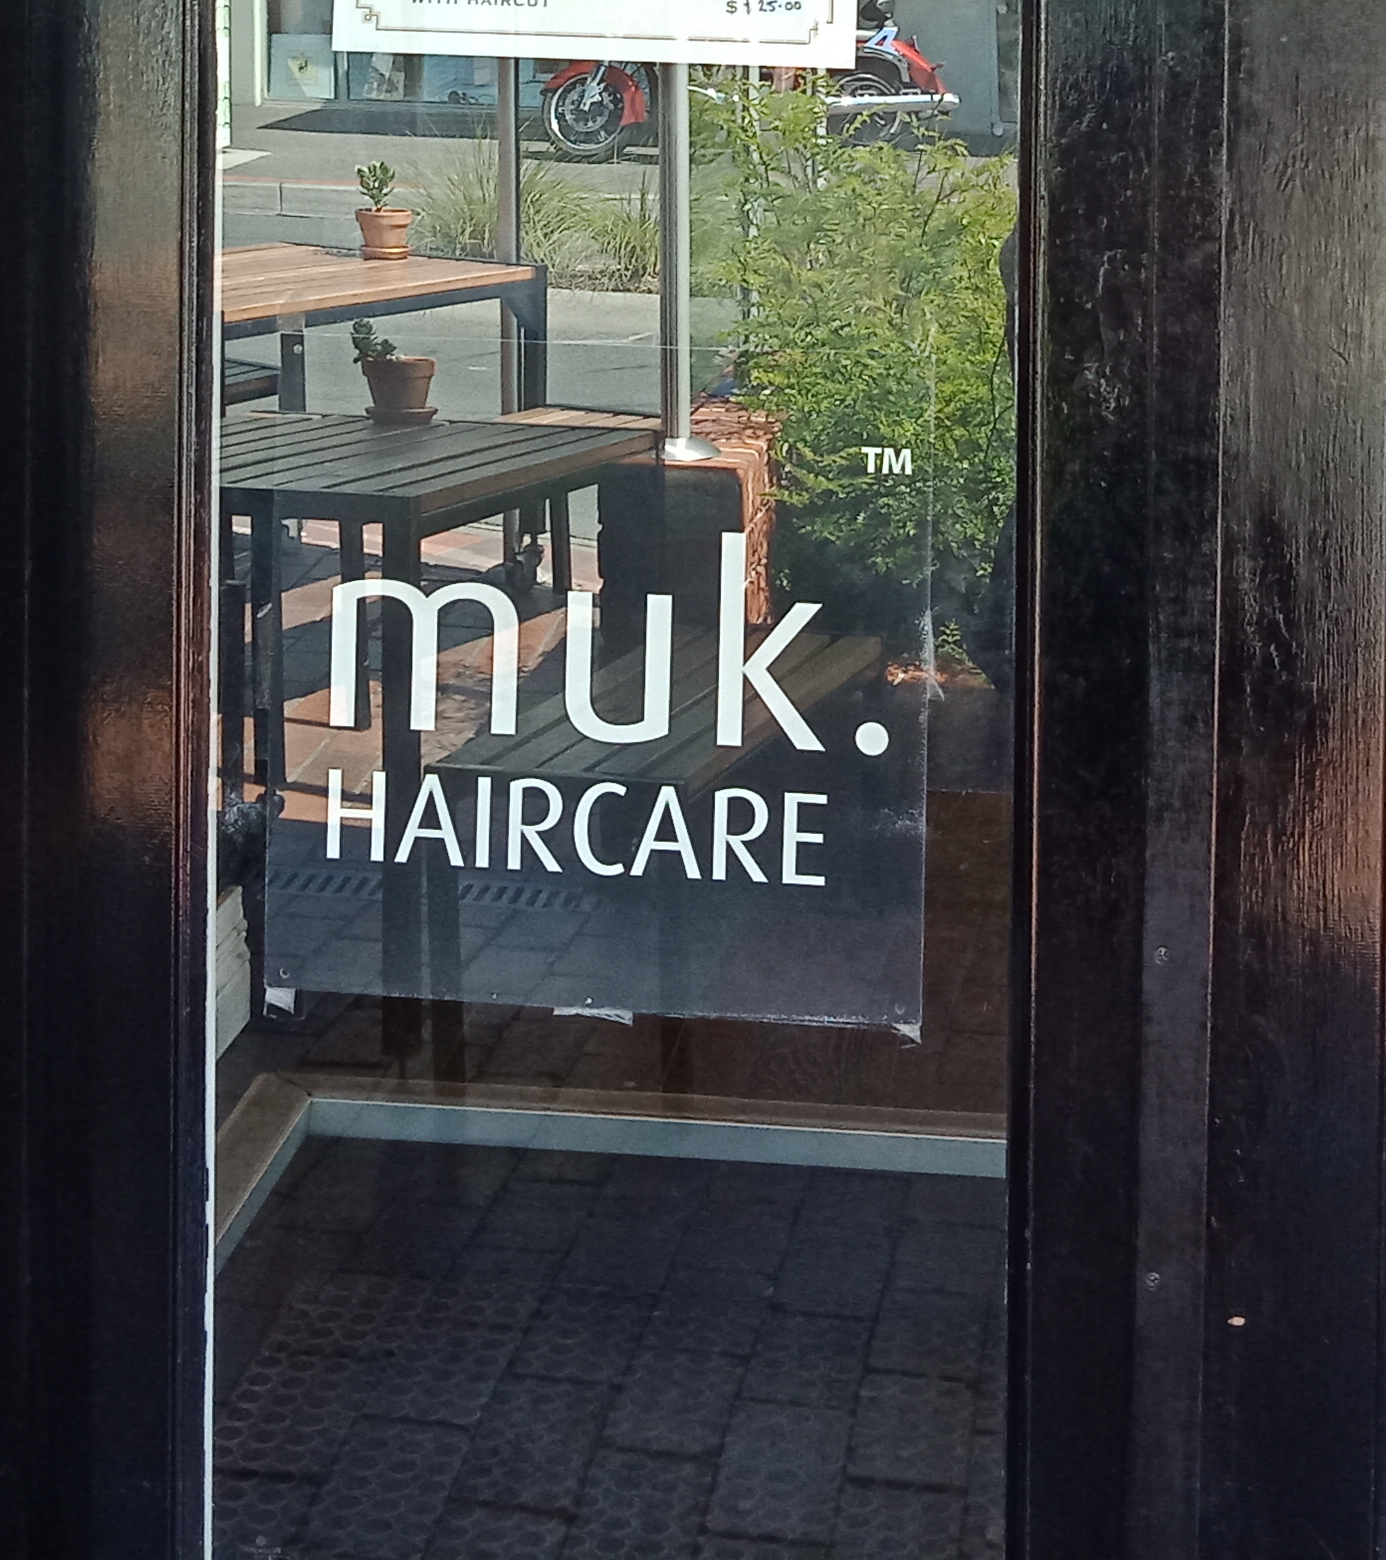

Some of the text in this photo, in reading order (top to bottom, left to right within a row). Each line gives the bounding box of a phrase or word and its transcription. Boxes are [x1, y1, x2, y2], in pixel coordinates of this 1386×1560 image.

[861, 446, 912, 476] TM
[329, 532, 890, 757] muk.
[325, 768, 830, 887] HAIRCARE
